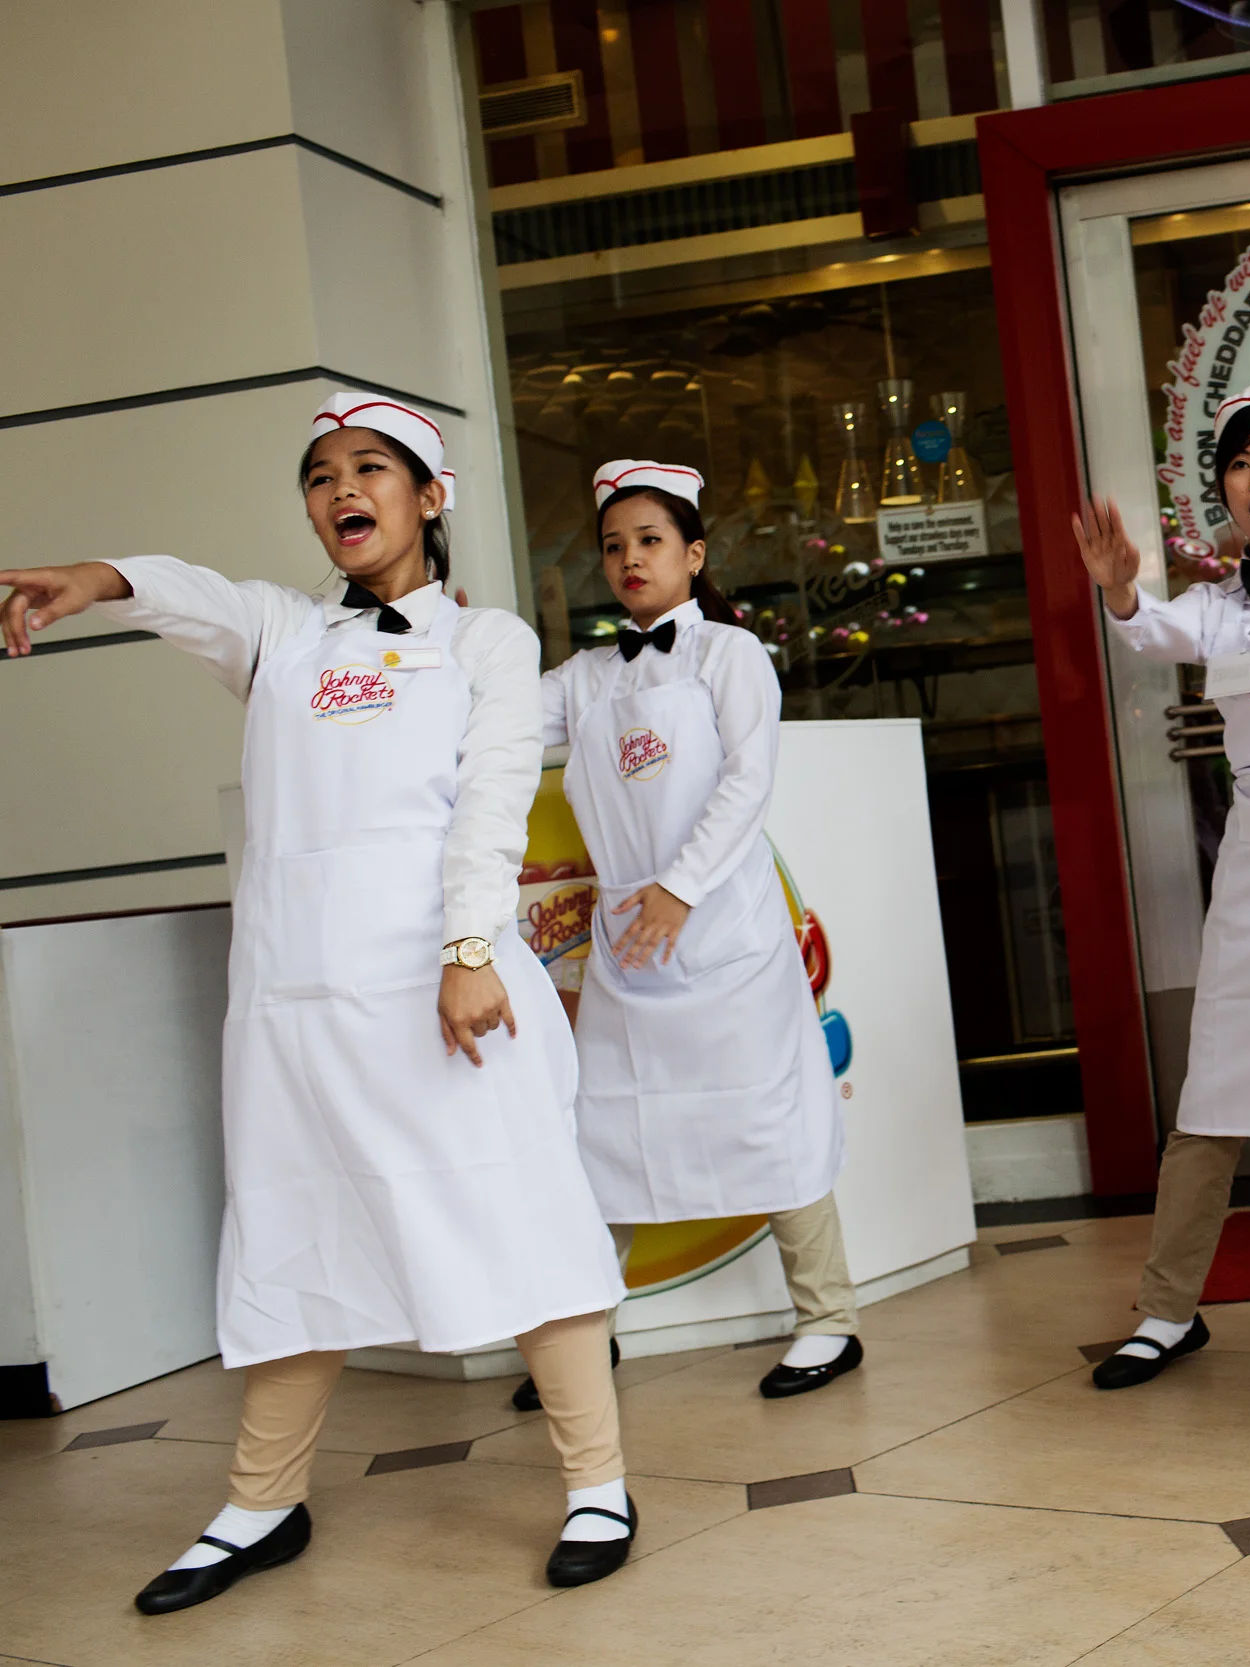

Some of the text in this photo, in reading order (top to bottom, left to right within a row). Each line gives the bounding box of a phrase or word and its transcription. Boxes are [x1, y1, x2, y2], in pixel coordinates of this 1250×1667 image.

[1202, 295, 1228, 328] up
[1169, 324, 1206, 388] fuel
[1165, 384, 1187, 442] and
[1157, 453, 1186, 484] In
[1197, 430, 1228, 527] BACON
[311, 669, 386, 709] Johnny
[320, 686, 395, 710] Rockets
[619, 729, 658, 772] Johnny
[624, 741, 667, 772] Rockets
[528, 885, 597, 953] Johnny
[542, 916, 592, 952] Rock
